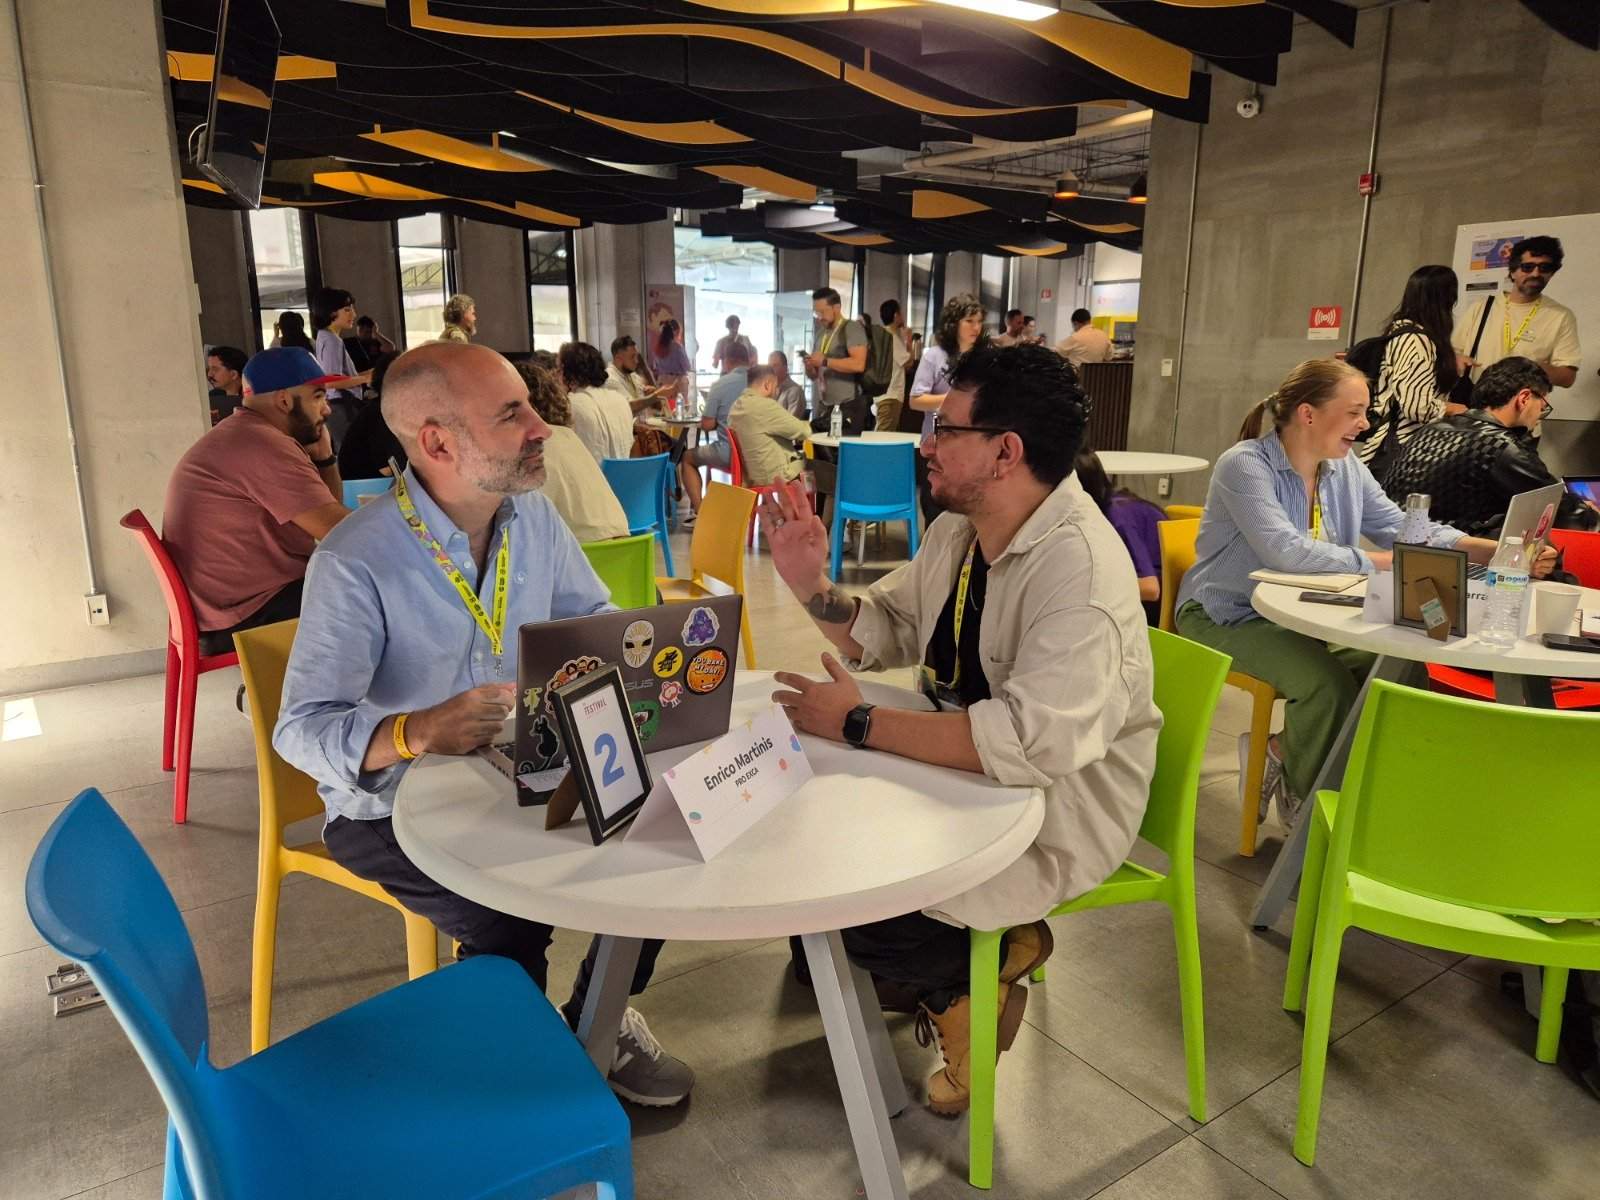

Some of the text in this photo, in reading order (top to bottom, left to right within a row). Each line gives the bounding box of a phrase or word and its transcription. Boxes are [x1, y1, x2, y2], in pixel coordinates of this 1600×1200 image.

[624, 679, 654, 691] SUS
[584, 698, 607, 716] FESTIVAL
[594, 733, 625, 788] 2
[703, 737, 773, 791] Enrico Martinis
[735, 775, 747, 787] PRO
